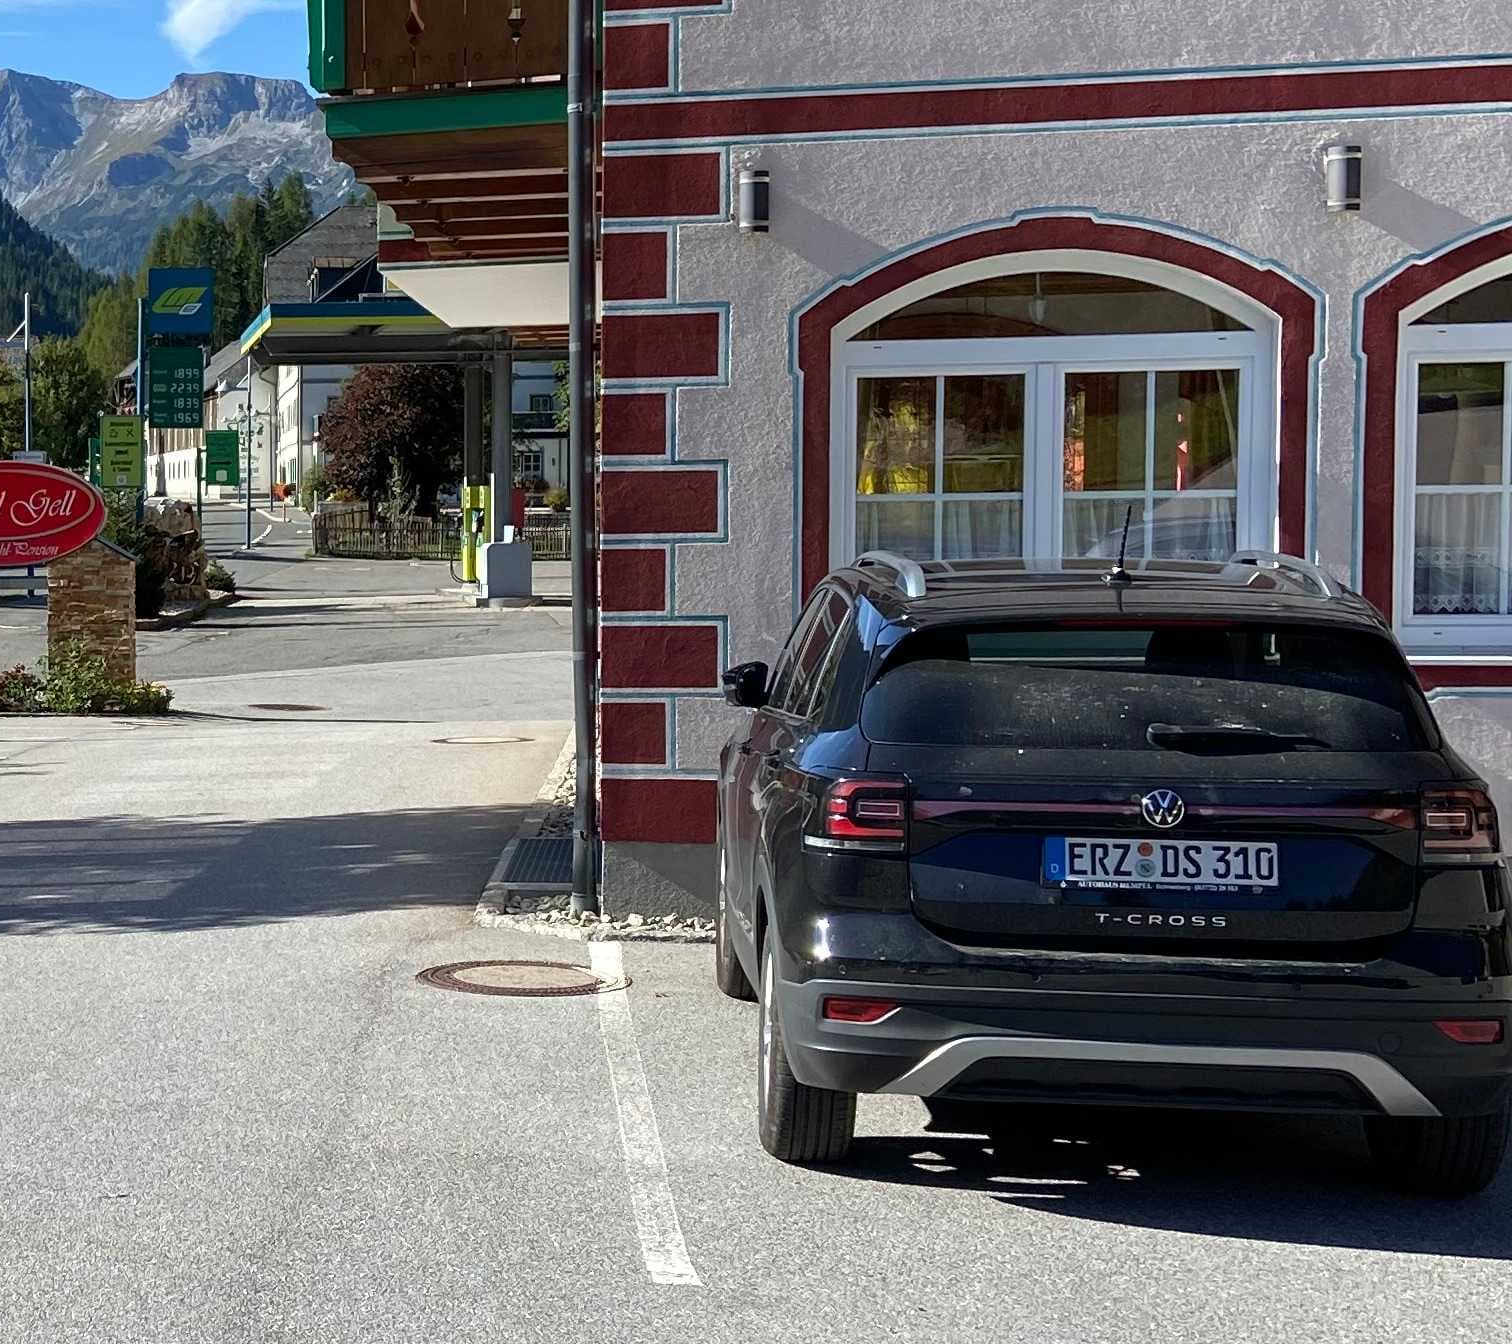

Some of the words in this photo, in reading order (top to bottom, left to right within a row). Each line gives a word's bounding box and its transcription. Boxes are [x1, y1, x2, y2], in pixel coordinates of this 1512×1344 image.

[10, 488, 77, 527] Gell
[1068, 842, 1133, 877] ERZ
[1159, 844, 1203, 879] DS
[1212, 845, 1275, 881] 310
[1094, 913, 1227, 927] T-CROSS
